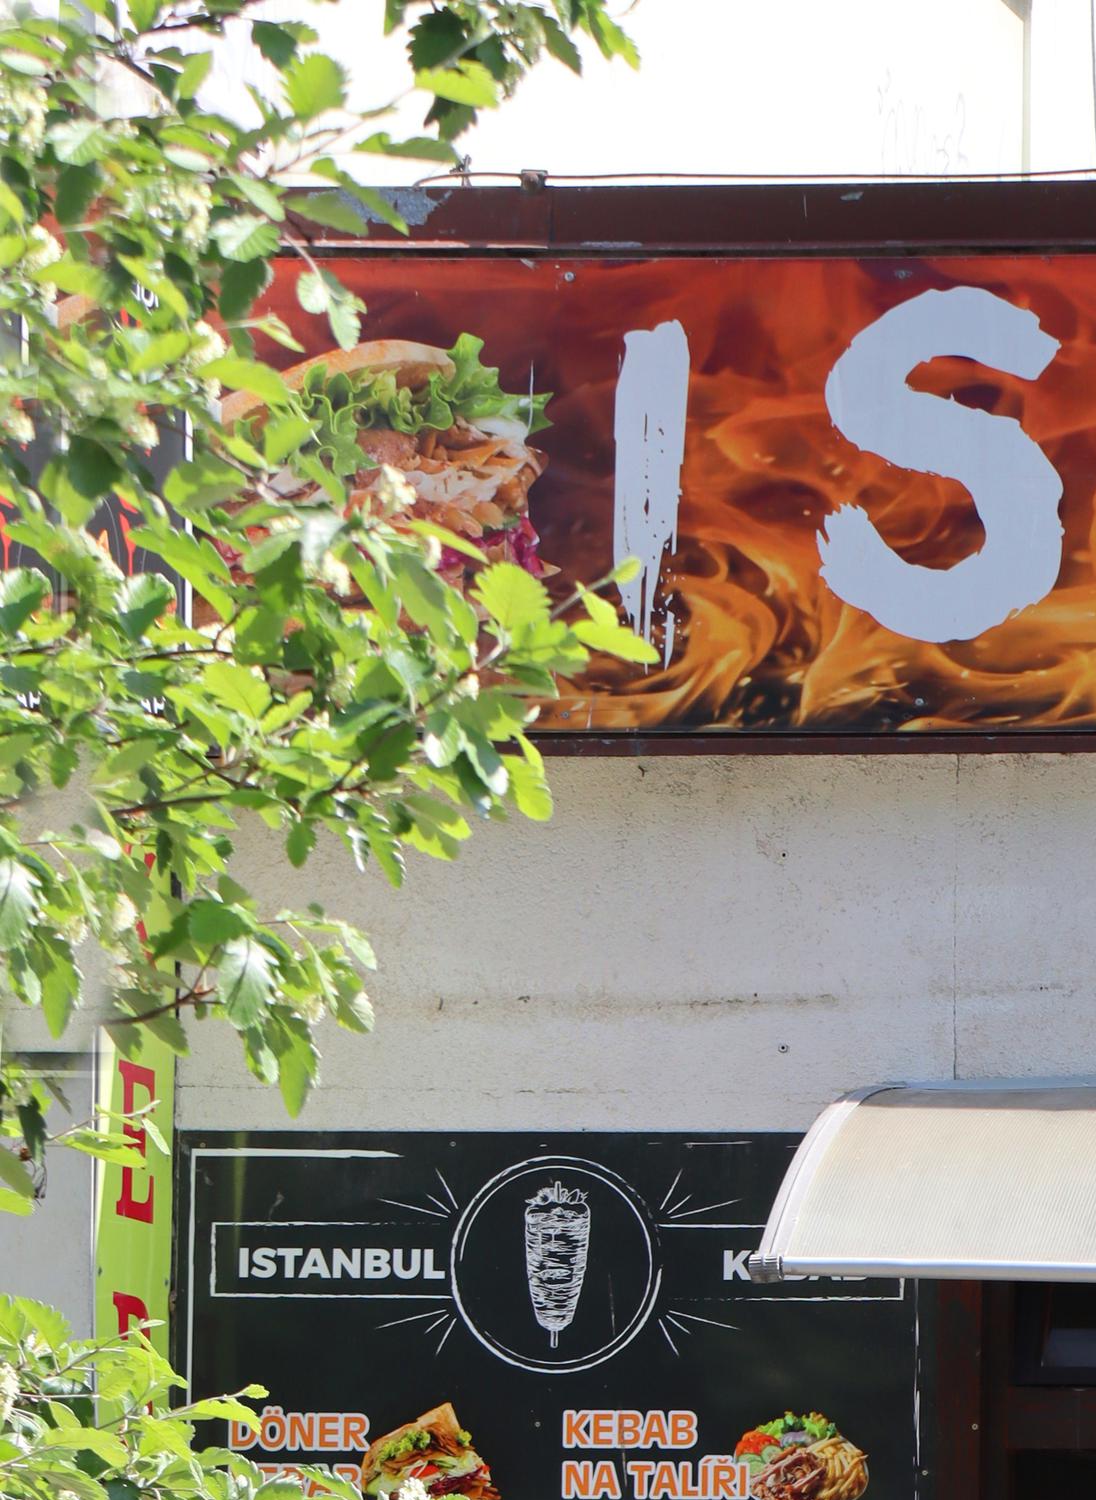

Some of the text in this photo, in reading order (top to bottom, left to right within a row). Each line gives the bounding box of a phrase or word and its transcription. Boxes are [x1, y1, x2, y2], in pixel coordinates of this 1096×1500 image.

[238, 1247, 446, 1280] ISTANBUL
[228, 1406, 370, 1451] DÖNER
[563, 1410, 698, 1448] KEBAB
[562, 1455, 750, 1500] NA TALÍŘI
